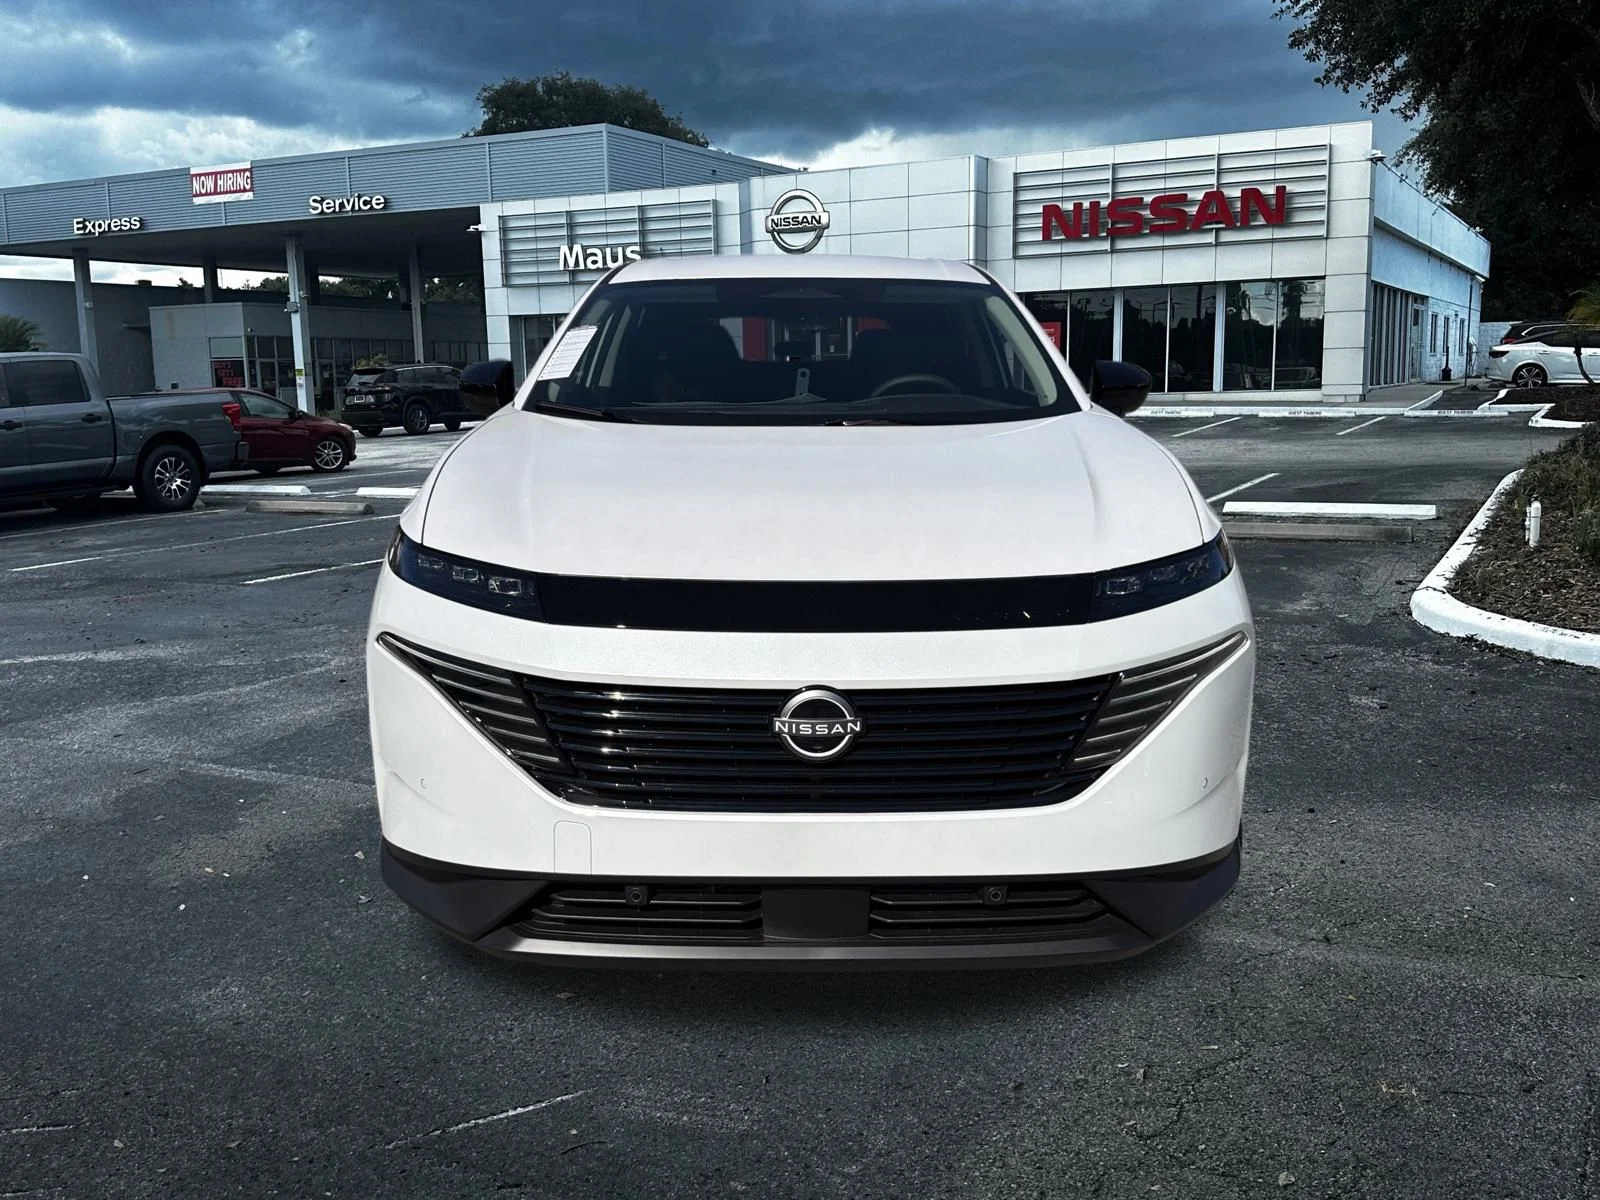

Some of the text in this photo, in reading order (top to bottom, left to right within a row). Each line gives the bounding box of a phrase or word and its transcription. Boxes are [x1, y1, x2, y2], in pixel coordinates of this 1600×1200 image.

[192, 171, 251, 194] NOW HIRING
[309, 192, 385, 214] Service
[1042, 185, 1287, 241] NISSAN
[73, 216, 141, 236] Express
[770, 215, 822, 228] NISSAN
[559, 243, 642, 271] Maus
[775, 721, 860, 735] NISSAN
